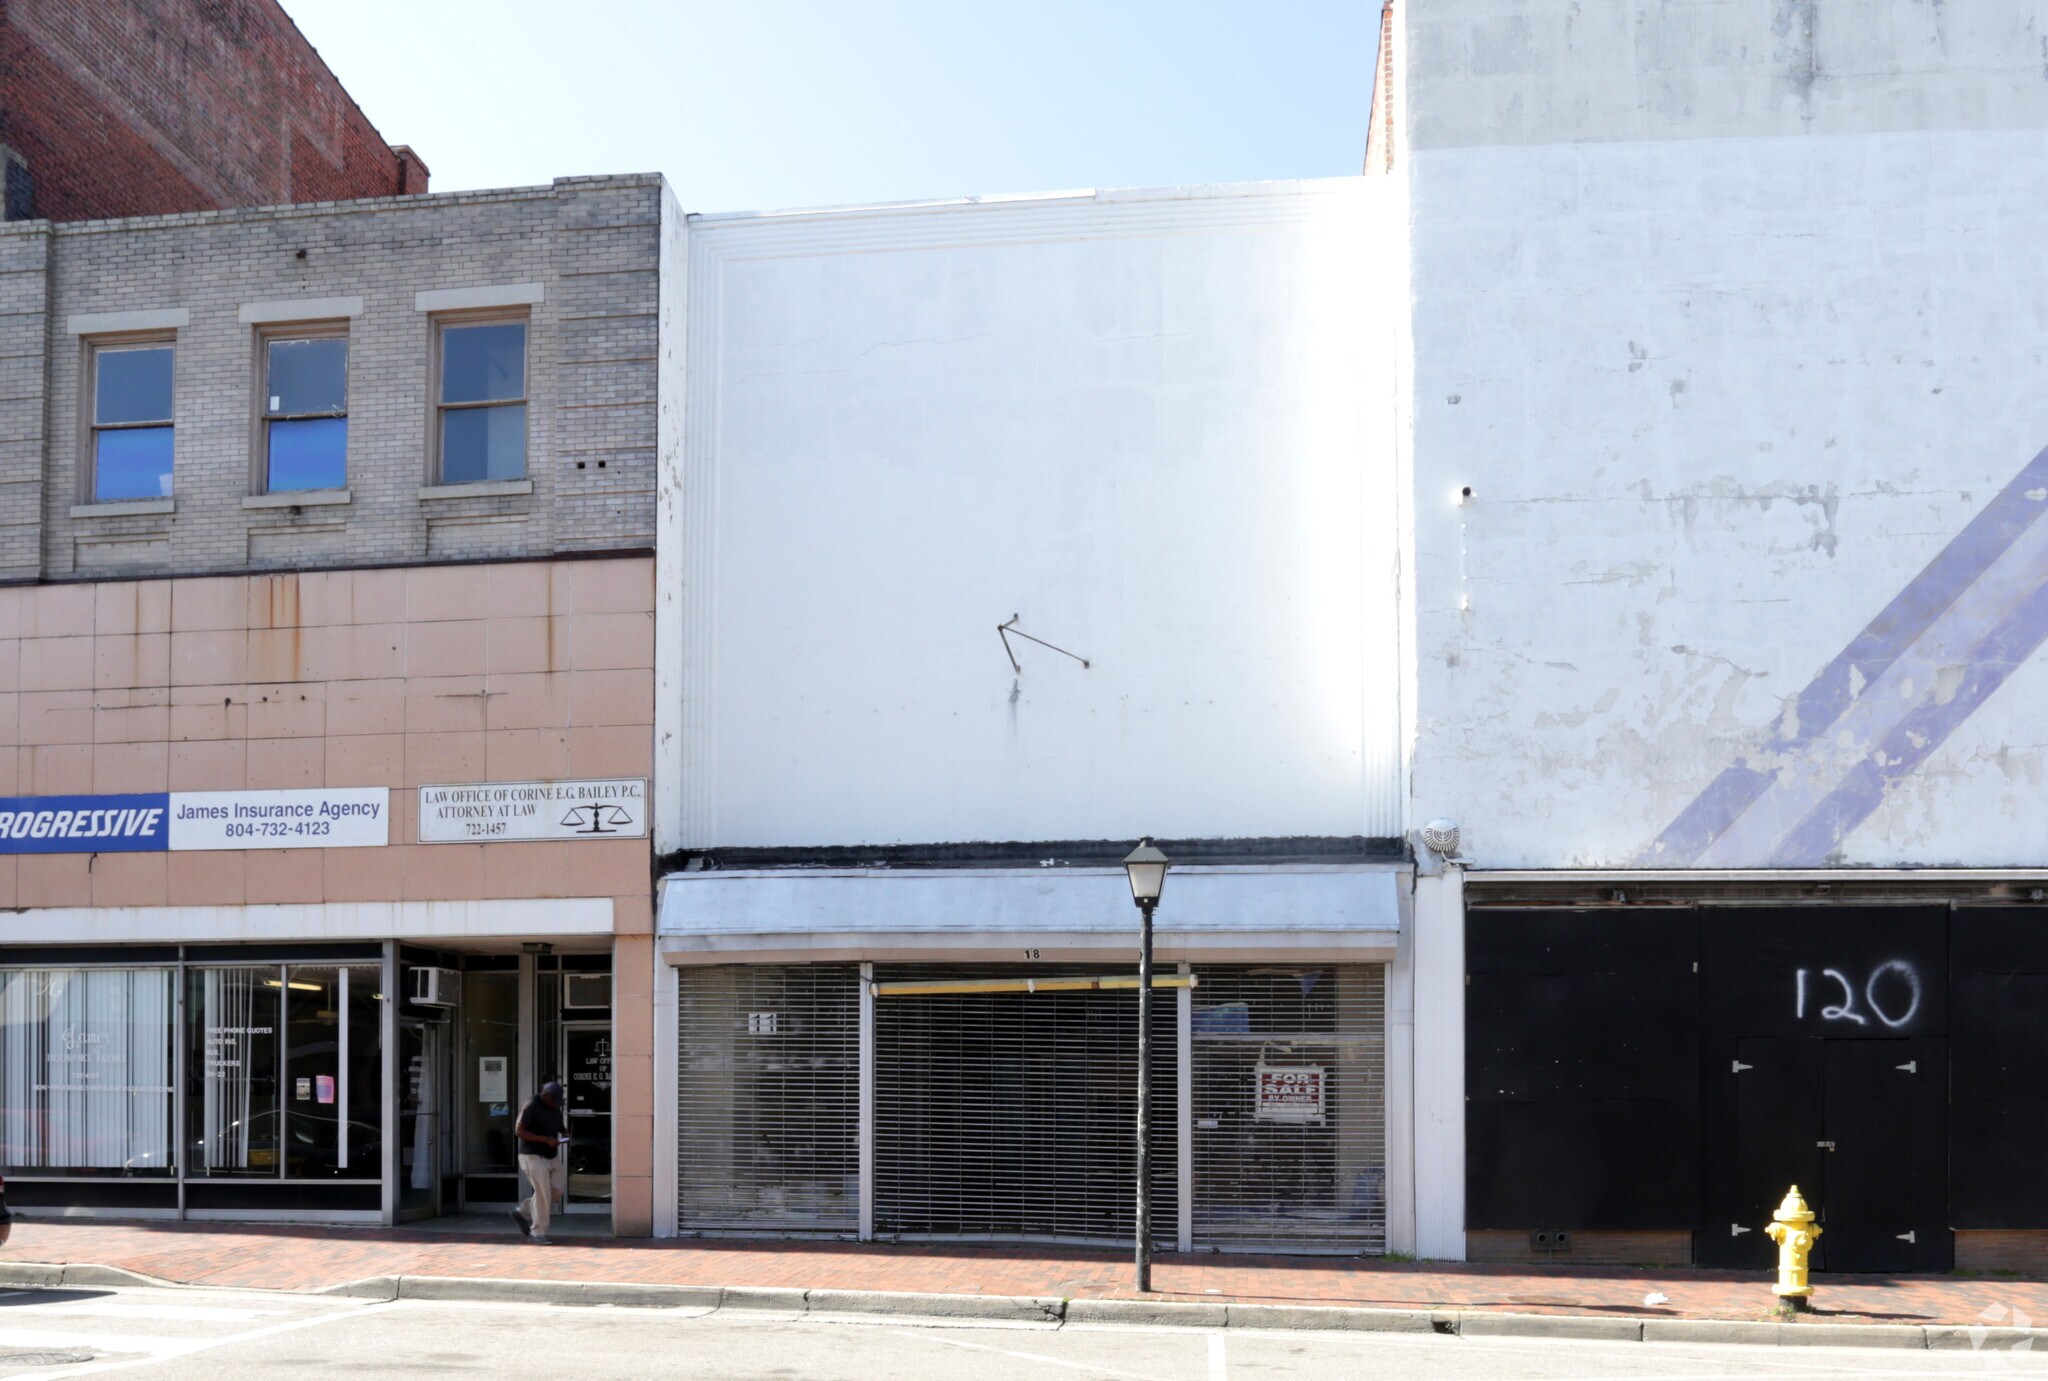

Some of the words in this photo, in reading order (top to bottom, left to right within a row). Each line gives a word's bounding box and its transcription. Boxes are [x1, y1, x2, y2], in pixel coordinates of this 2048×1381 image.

[425, 792, 448, 804] LAW
[451, 789, 491, 803] OFFICE
[494, 788, 509, 801] OF
[511, 786, 553, 801] CORINE
[578, 784, 619, 798] BAILEY
[621, 783, 640, 798] P.C.
[177, 803, 229, 820] James
[235, 802, 314, 819] Insurance
[319, 801, 380, 820] Agency
[437, 805, 495, 819] ATTORNEY
[497, 804, 511, 817] AT
[513, 804, 536, 817] LAW
[225, 821, 330, 837] 804-732-4123
[465, 822, 507, 836] 722-1457
[1025, 949, 1040, 959] 18
[1796, 960, 1921, 1028] 120
[1271, 1074, 1309, 1084] FOR
[1264, 1084, 1316, 1095] SALE
[1283, 1095, 1312, 1103] OWNER
